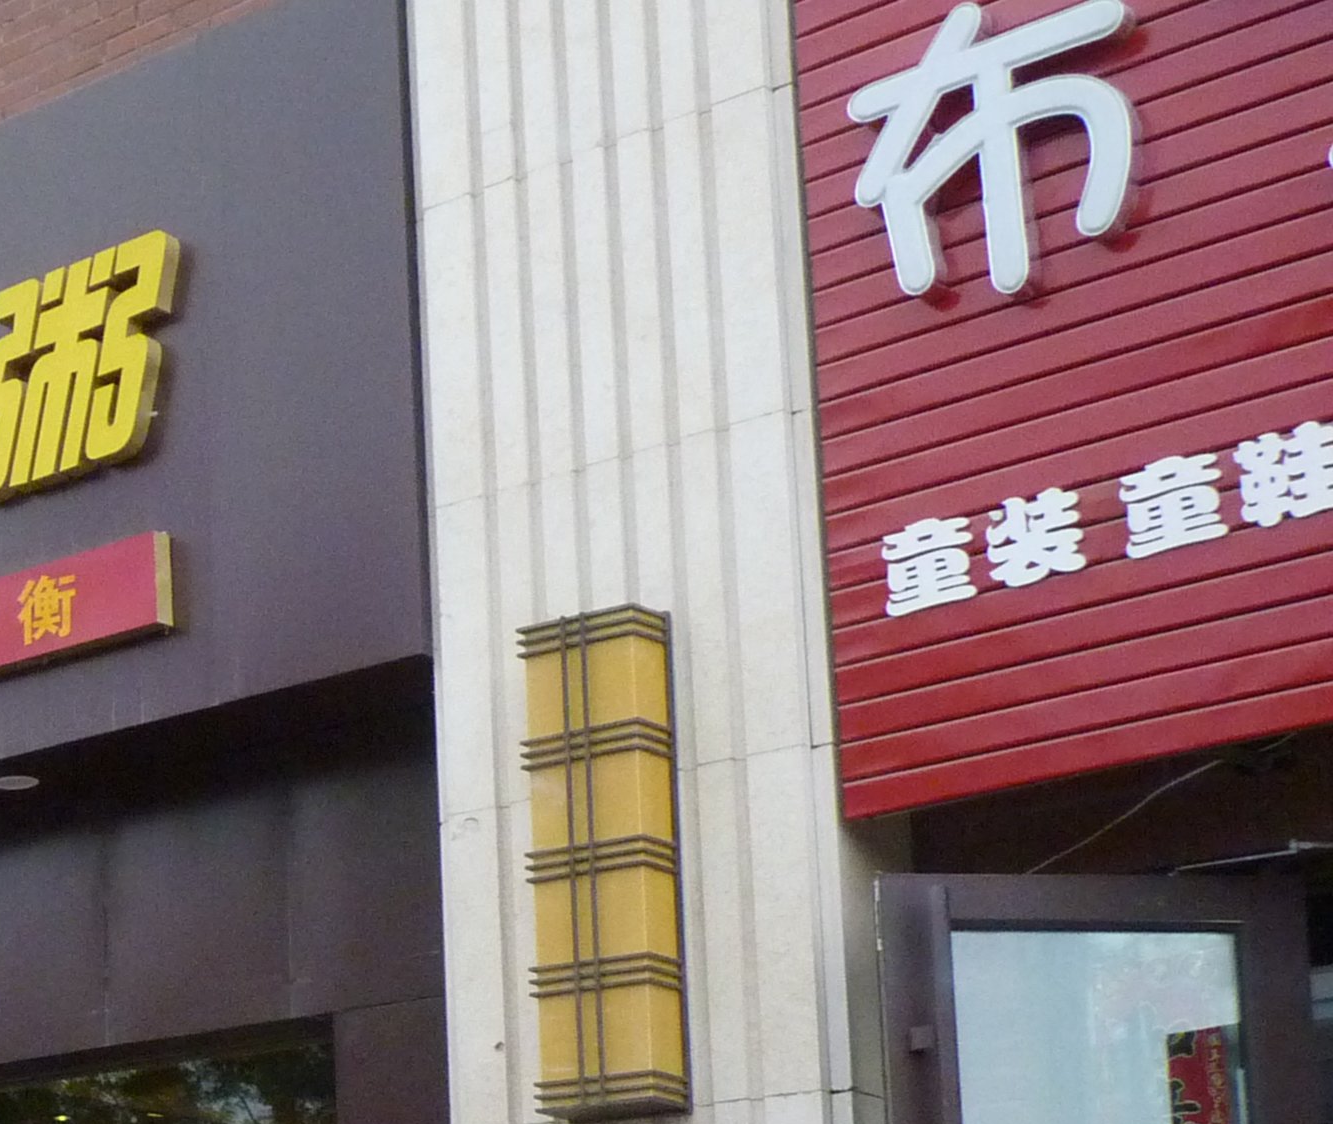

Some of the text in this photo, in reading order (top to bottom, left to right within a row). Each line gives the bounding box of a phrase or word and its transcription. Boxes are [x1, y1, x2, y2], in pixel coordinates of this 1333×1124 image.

[848, 0, 1131, 294] 布
[881, 421, 1333, 617] 童装 童鞋
